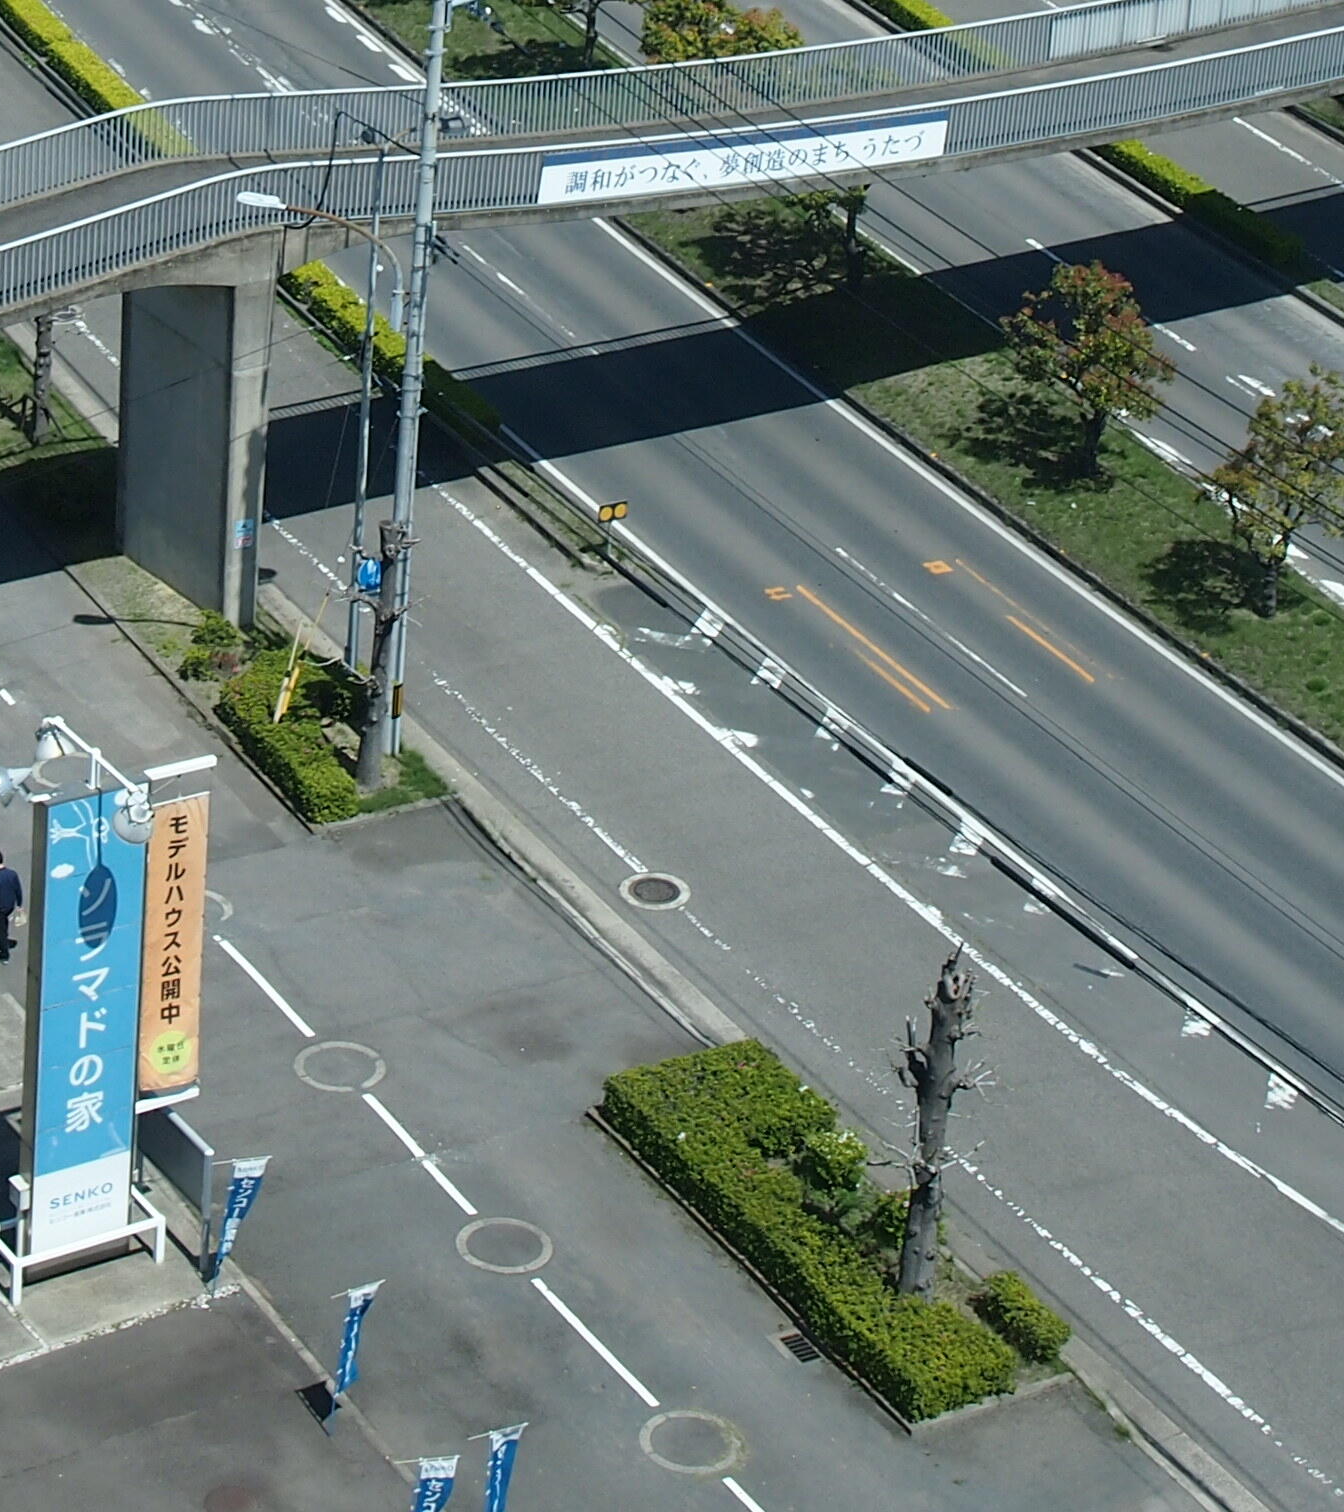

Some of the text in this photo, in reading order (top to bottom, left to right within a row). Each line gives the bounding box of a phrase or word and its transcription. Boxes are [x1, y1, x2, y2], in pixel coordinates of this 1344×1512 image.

[862, 131, 926, 158] うたづ
[159, 814, 188, 1025] モデルハウス公開中
[64, 876, 111, 1133] ソラマドの家
[49, 1182, 113, 1210] SENKO
